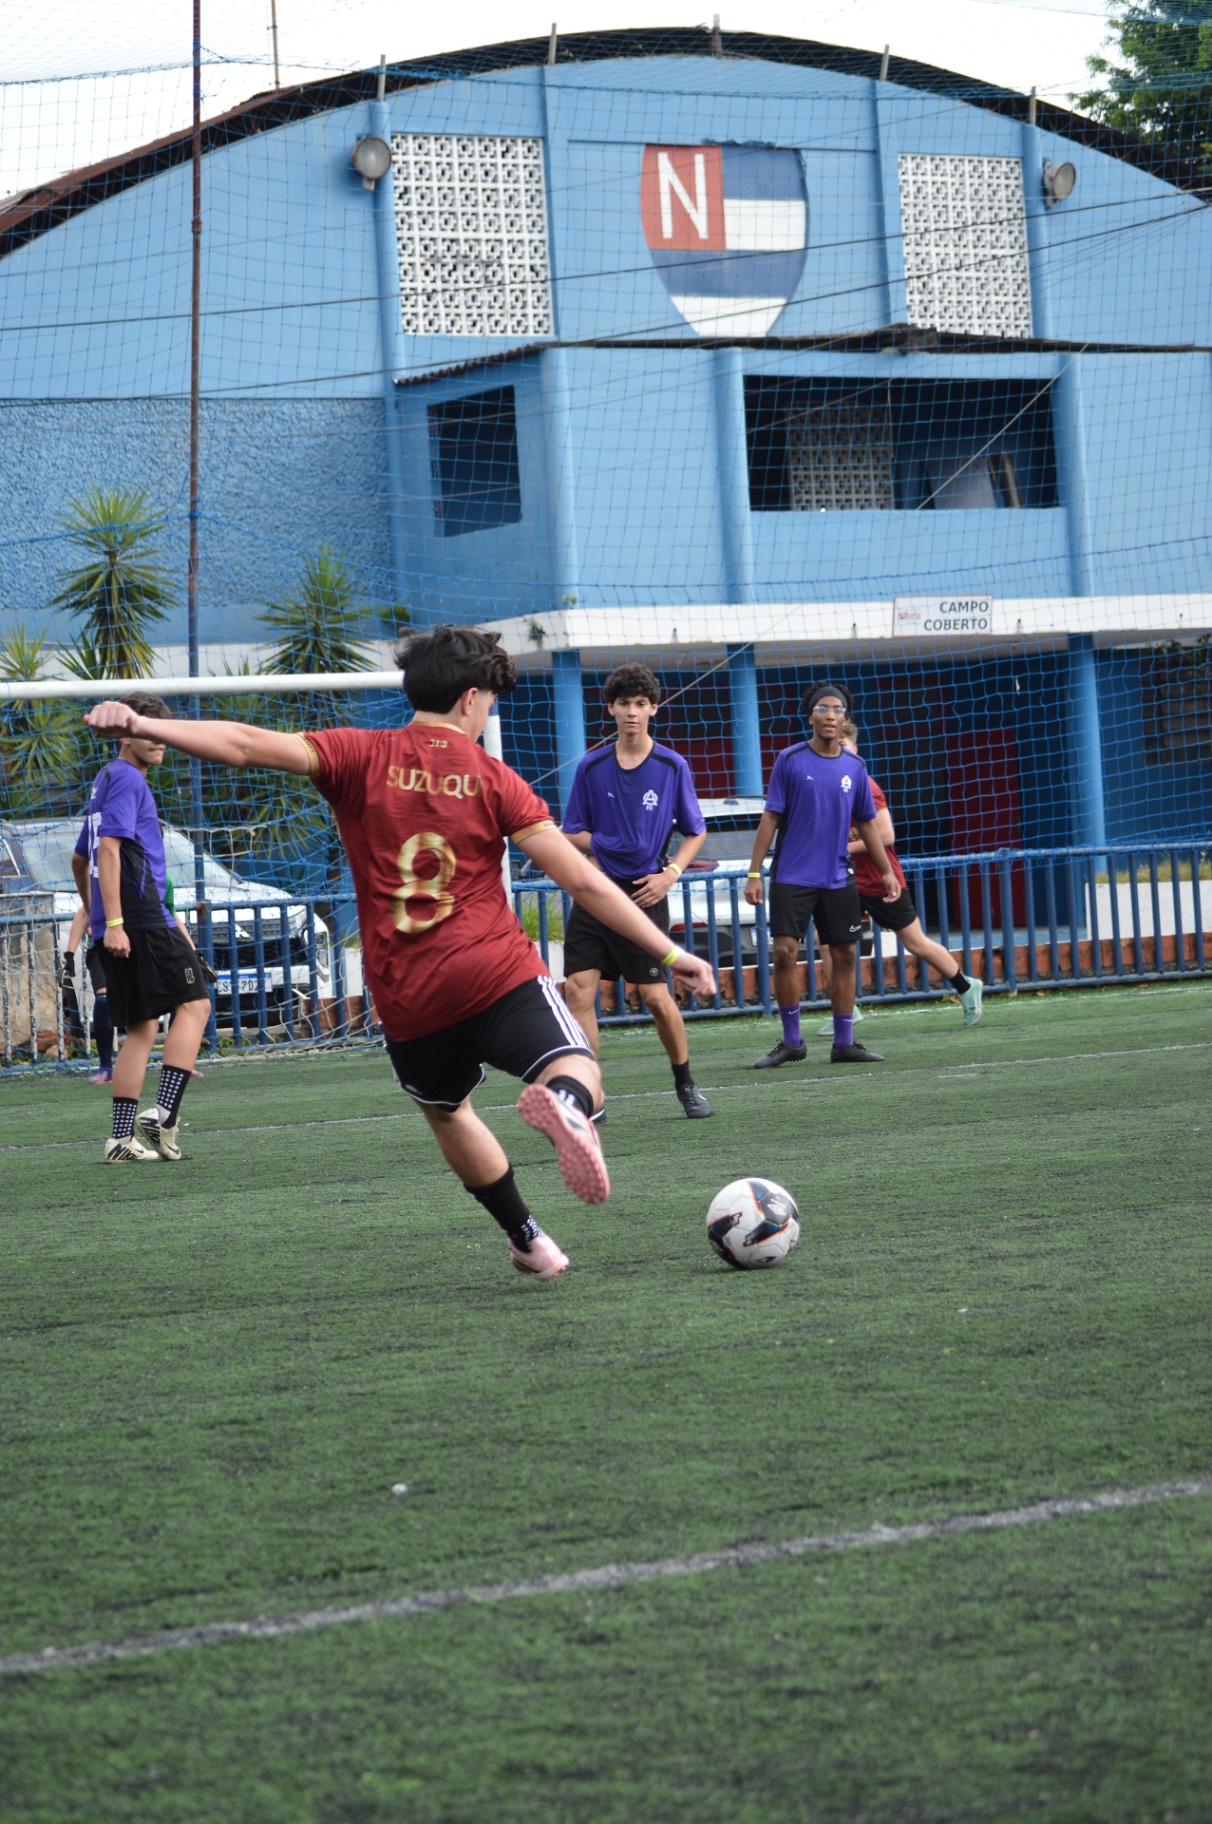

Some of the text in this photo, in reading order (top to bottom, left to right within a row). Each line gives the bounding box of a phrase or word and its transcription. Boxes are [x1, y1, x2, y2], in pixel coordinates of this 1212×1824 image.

[939, 600, 989, 614] CAMPO
[923, 618, 988, 631] COBERTO
[390, 831, 457, 935] 8
